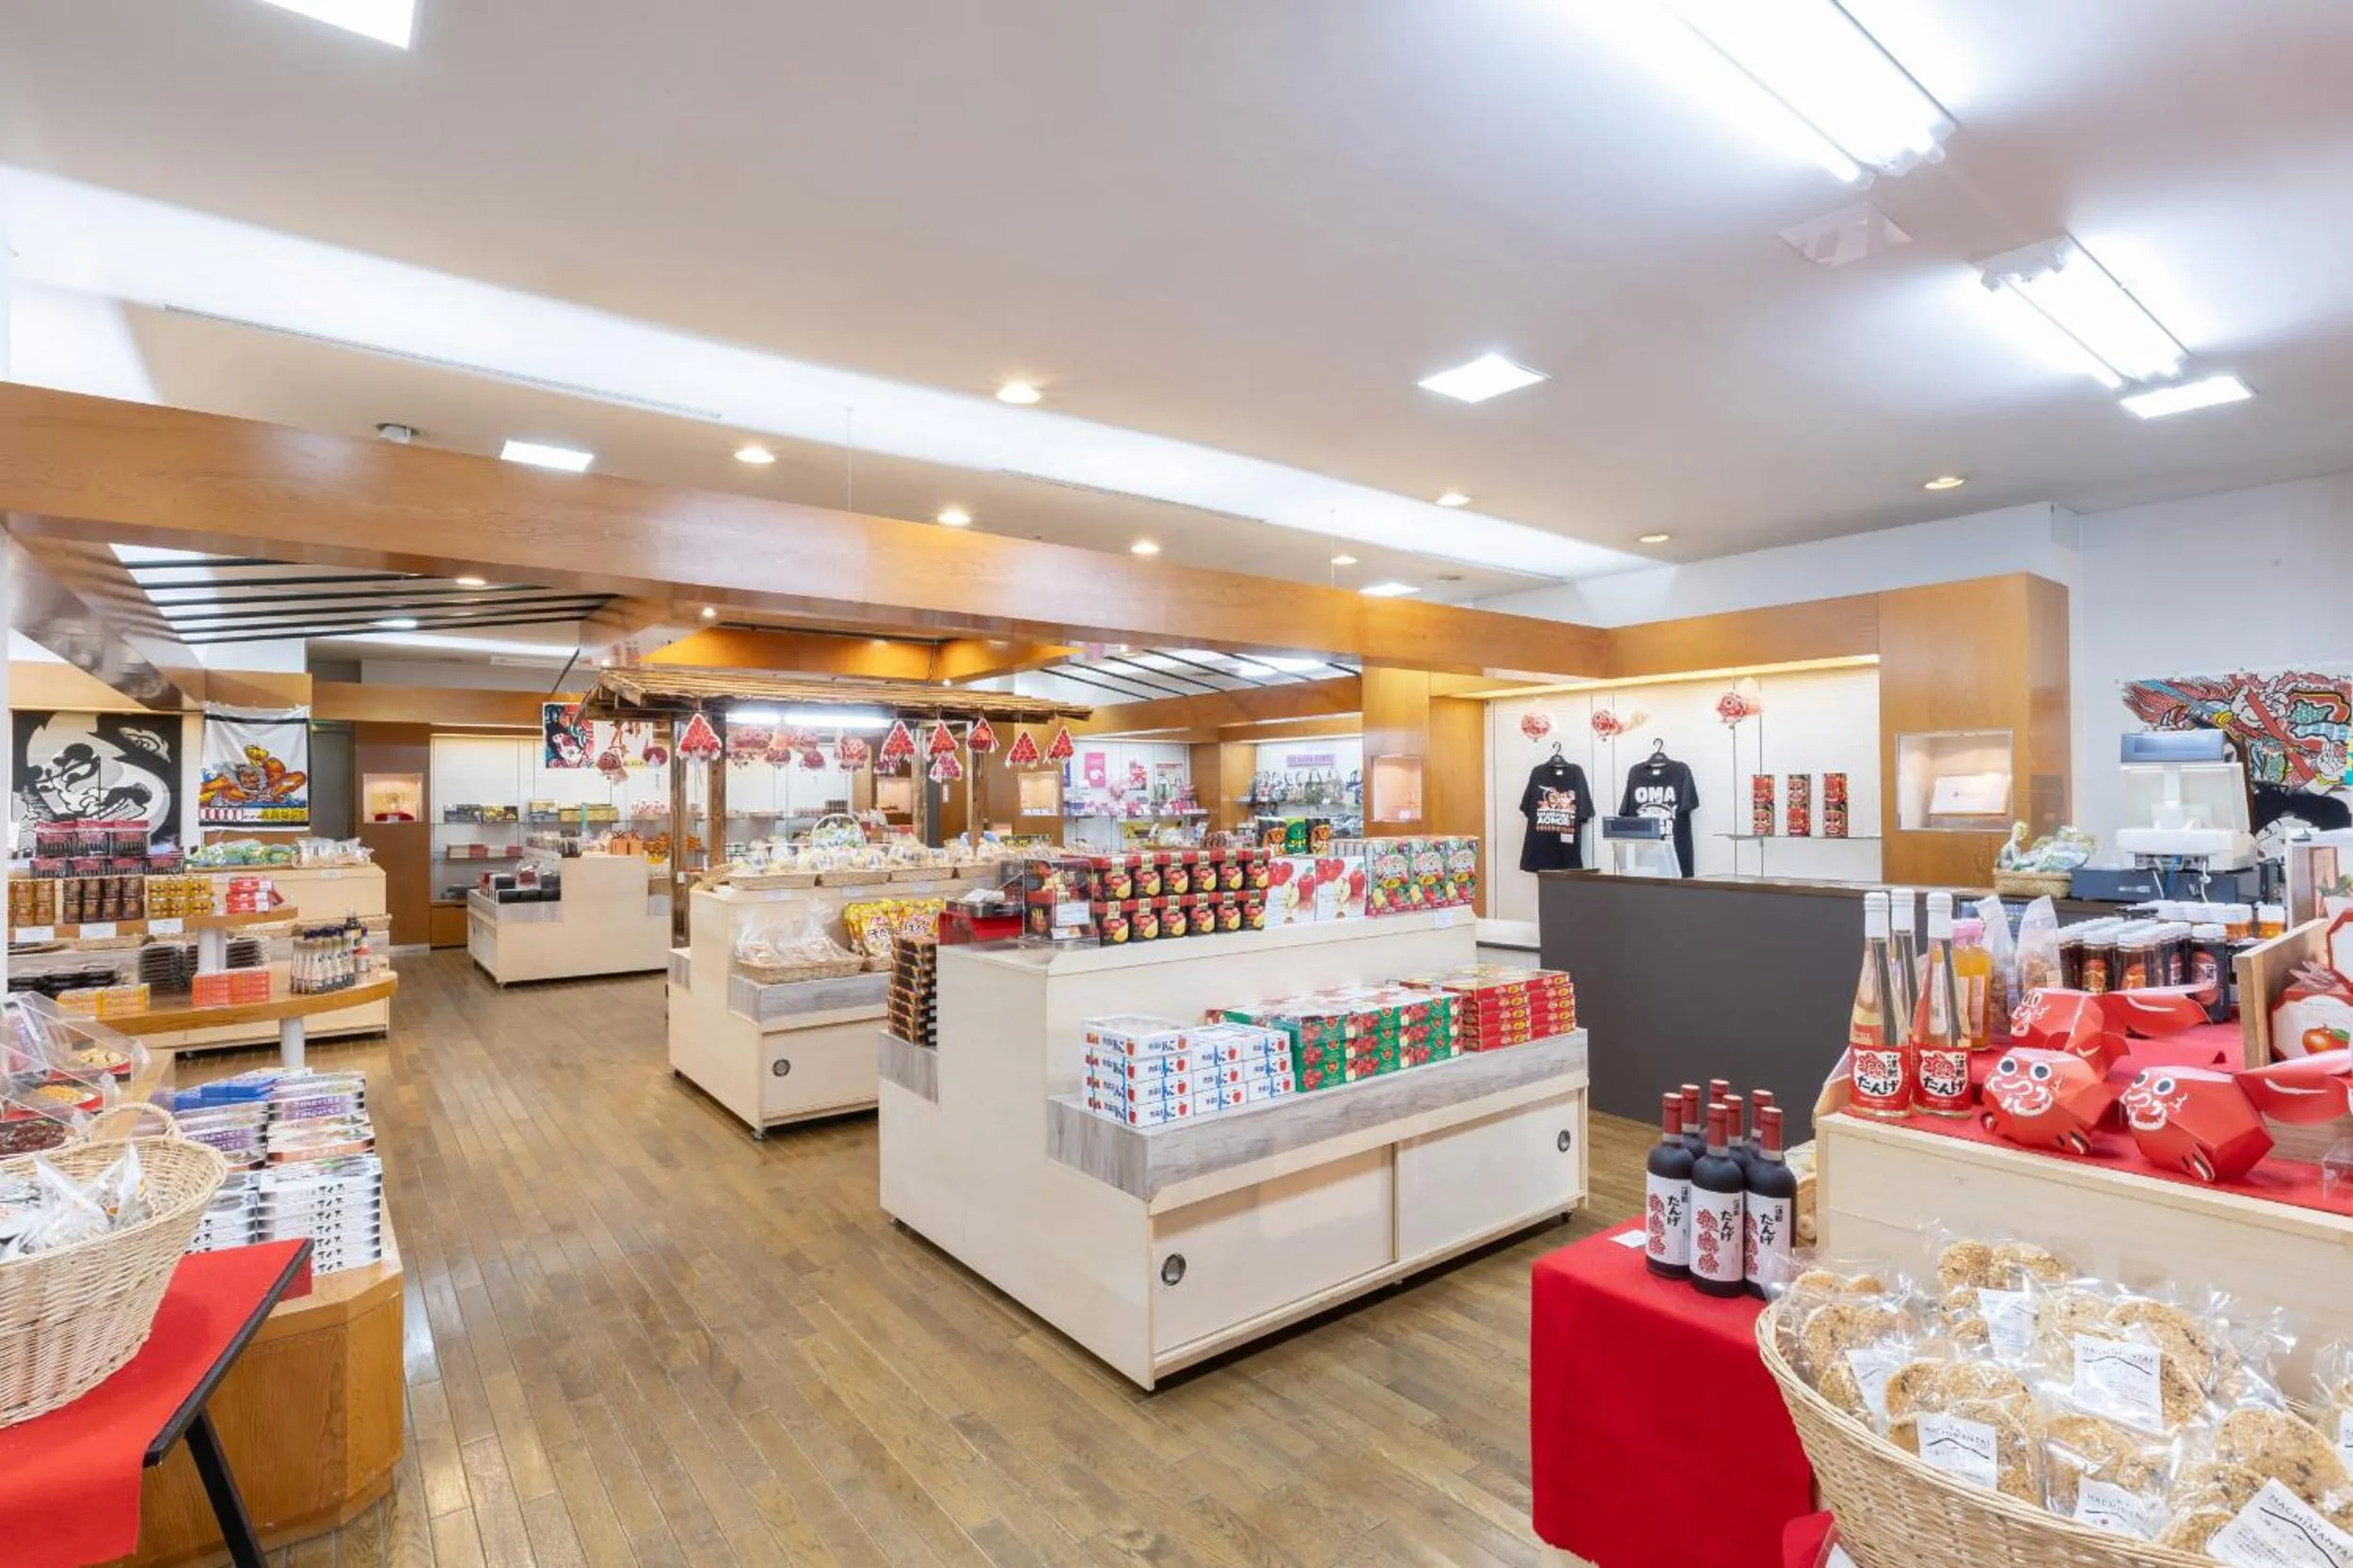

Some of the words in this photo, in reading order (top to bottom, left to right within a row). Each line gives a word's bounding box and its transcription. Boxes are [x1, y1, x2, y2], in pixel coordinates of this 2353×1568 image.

[1634, 785, 1676, 803] OMA
[1856, 1075, 1899, 1095] たんげ
[1922, 1076, 1965, 1095] たんげ
[1667, 1196, 1682, 1227] たんげ
[1721, 1210, 1735, 1242] たんげ
[1760, 1213, 1776, 1245] たんげ
[2268, 1494, 2348, 1559] HACHIMANTA
